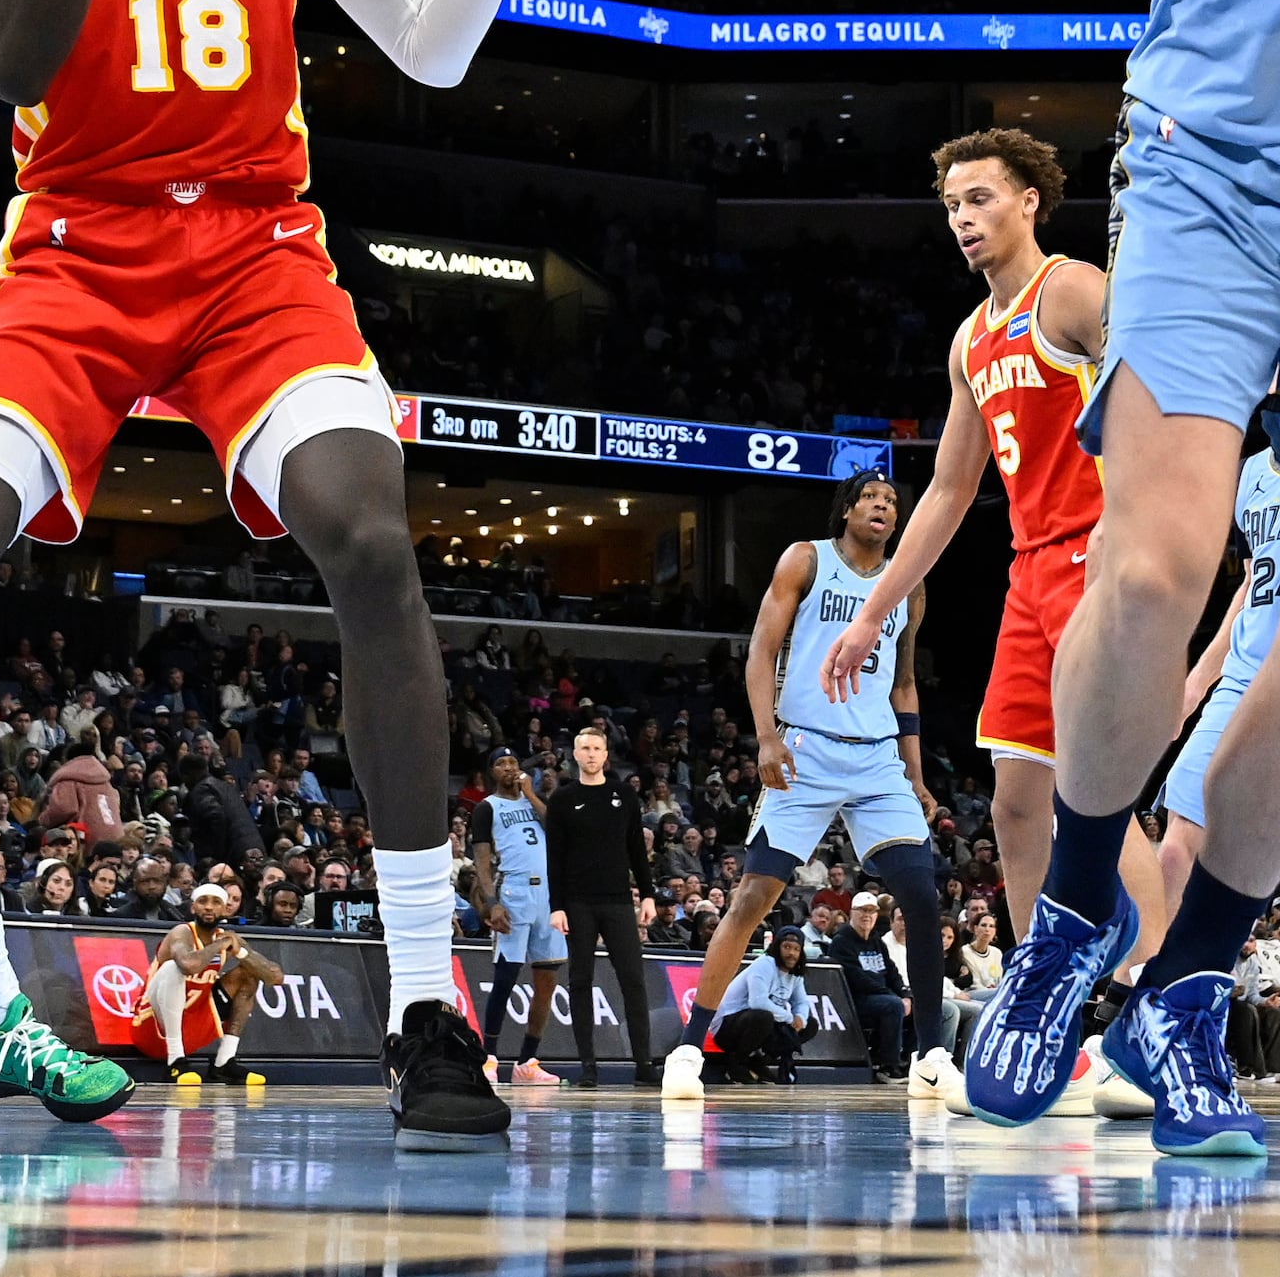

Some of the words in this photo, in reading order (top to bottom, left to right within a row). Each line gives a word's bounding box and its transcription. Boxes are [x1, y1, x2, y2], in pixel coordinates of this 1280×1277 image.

[711, 22, 827, 43] MILAGRO
[835, 21, 945, 43] TEQUILA
[165, 181, 206, 195] HAWKS
[369, 243, 448, 272] KONICA
[448, 253, 535, 282] MINOLTA
[432, 407, 465, 438] 3RD
[470, 418, 498, 441] QTR
[518, 410, 576, 451] 3:40
[606, 418, 693, 443] TIMEOUTS:
[694, 428, 707, 444] 4
[606, 440, 663, 459] FOULS:
[665, 443, 678, 461] 2
[746, 431, 802, 474] 82
[991, 410, 1021, 477] 5
[522, 827, 540, 846] 3
[346, 900, 374, 918] Replay
